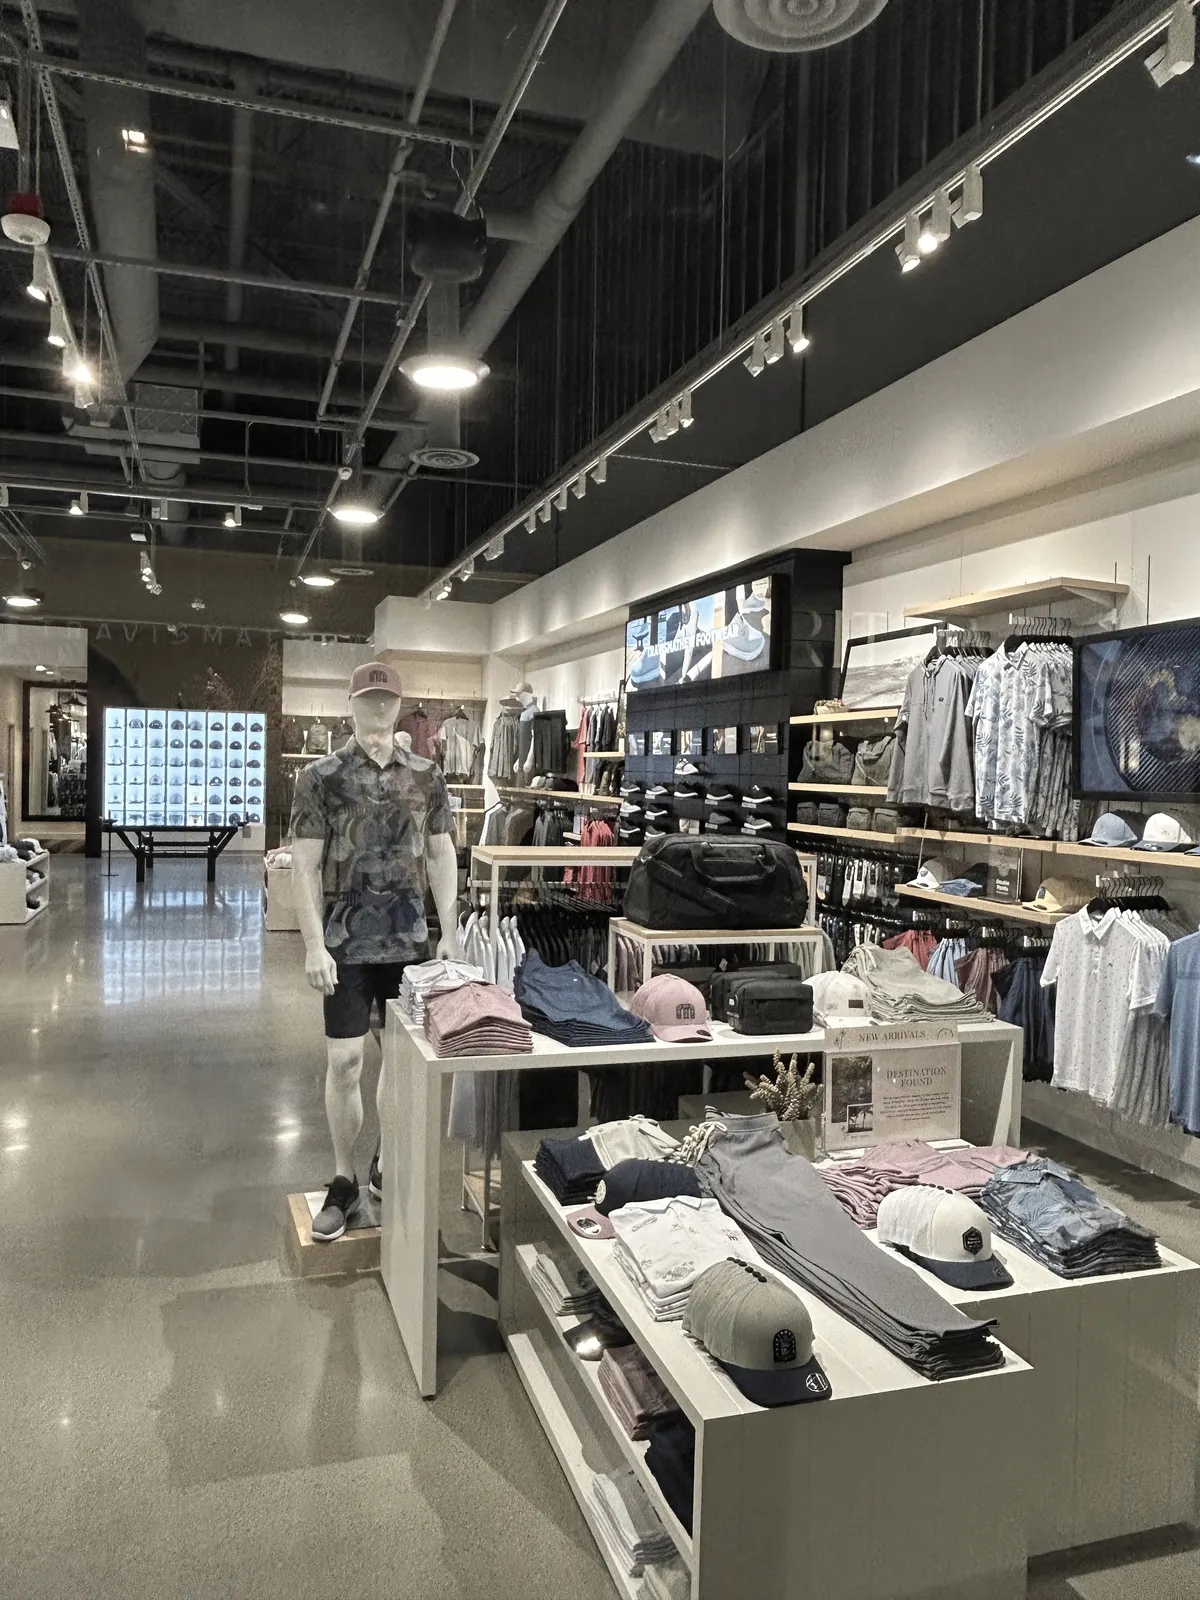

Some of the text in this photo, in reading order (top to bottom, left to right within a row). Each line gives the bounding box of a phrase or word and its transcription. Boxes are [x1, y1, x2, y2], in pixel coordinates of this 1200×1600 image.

[696, 624, 739, 646] FOOTWEAR
[858, 1029, 926, 1043] NEW ARRIVALS
[886, 1066, 947, 1080] DESTINATION
[900, 1077, 933, 1088] FOUND
